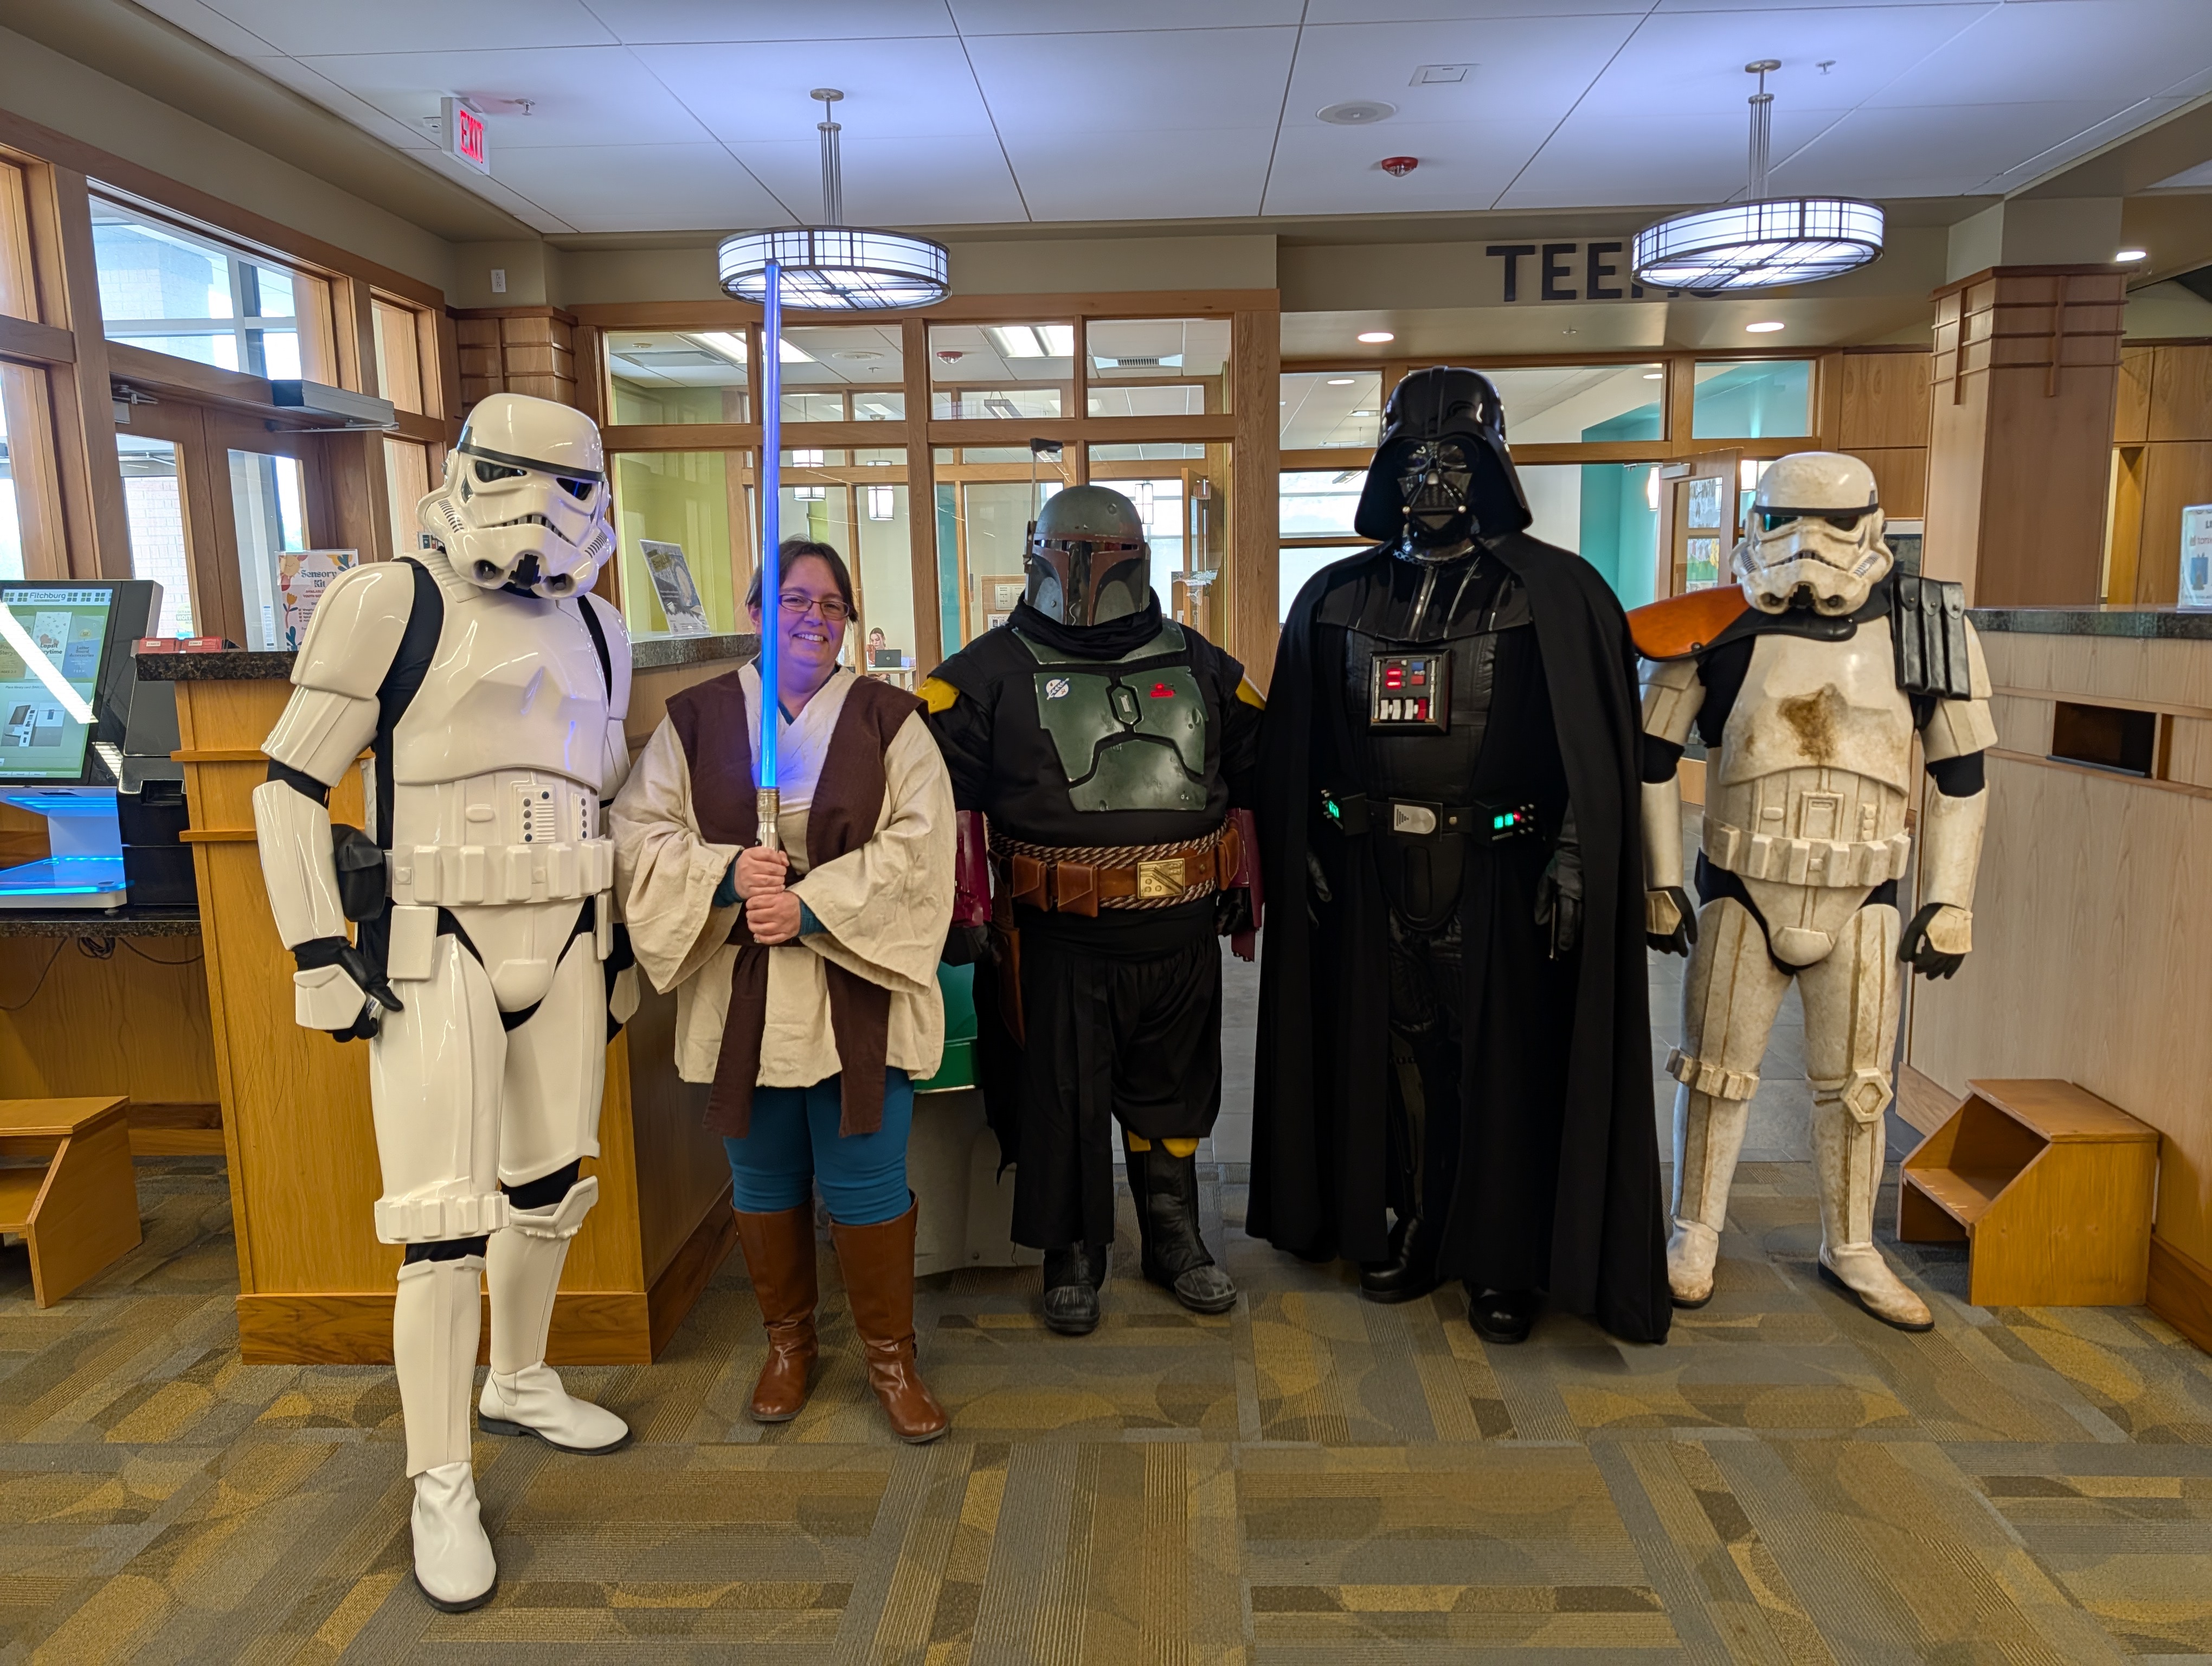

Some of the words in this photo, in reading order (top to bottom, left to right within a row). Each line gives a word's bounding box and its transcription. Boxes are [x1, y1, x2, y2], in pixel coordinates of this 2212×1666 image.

[460, 109, 483, 164] EXIT
[1486, 242, 1722, 302] TEE
[301, 569, 337, 579] Sensory
[30, 592, 66, 600] Fitchburg
